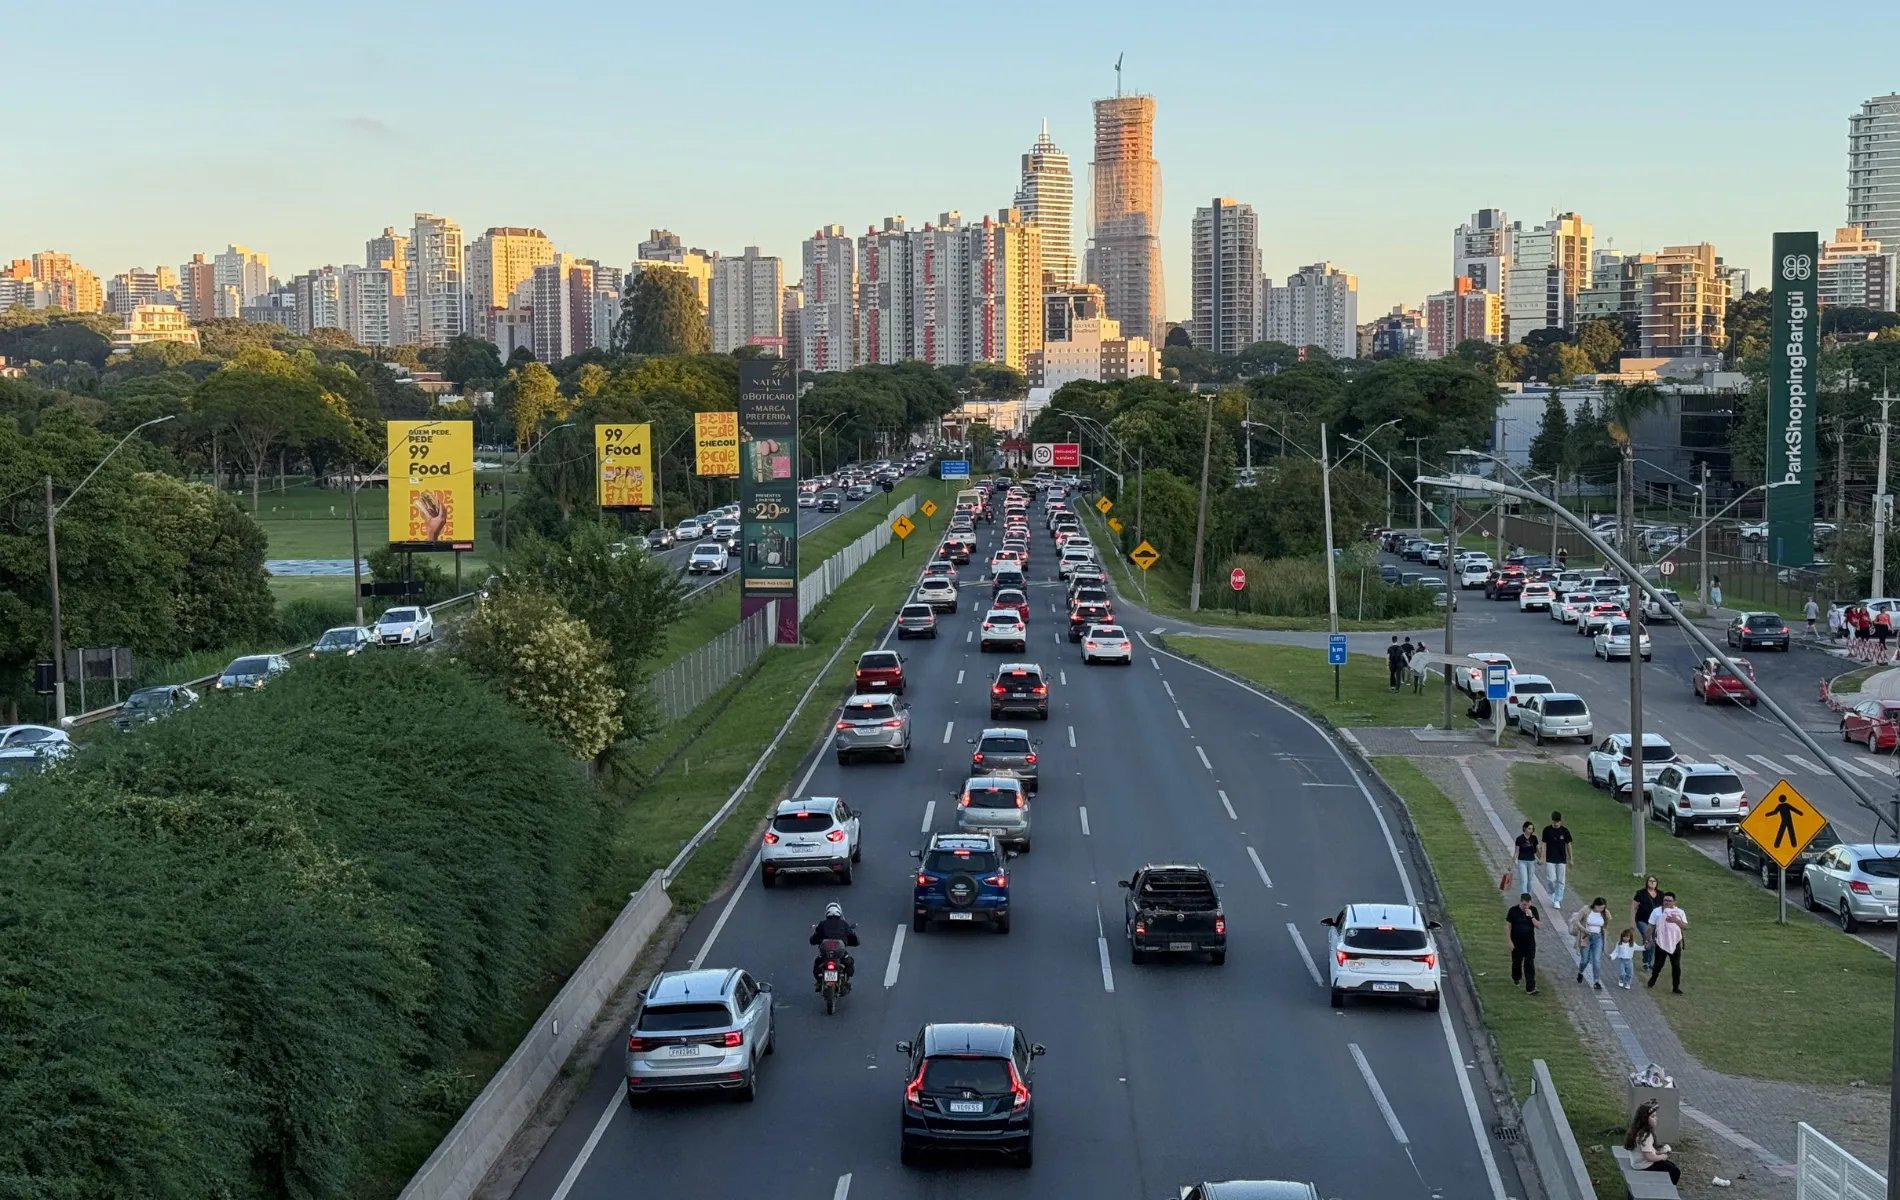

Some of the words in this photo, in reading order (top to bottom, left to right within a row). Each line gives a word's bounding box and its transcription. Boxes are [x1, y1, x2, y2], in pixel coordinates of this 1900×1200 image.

[1785, 291, 1807, 484] ParkShoppingBarigüi
[605, 429, 622, 441] 99
[409, 445, 429, 459] 99
[605, 444, 641, 455] Food
[1038, 450, 1048, 458] 50
[409, 461, 450, 475] Food
